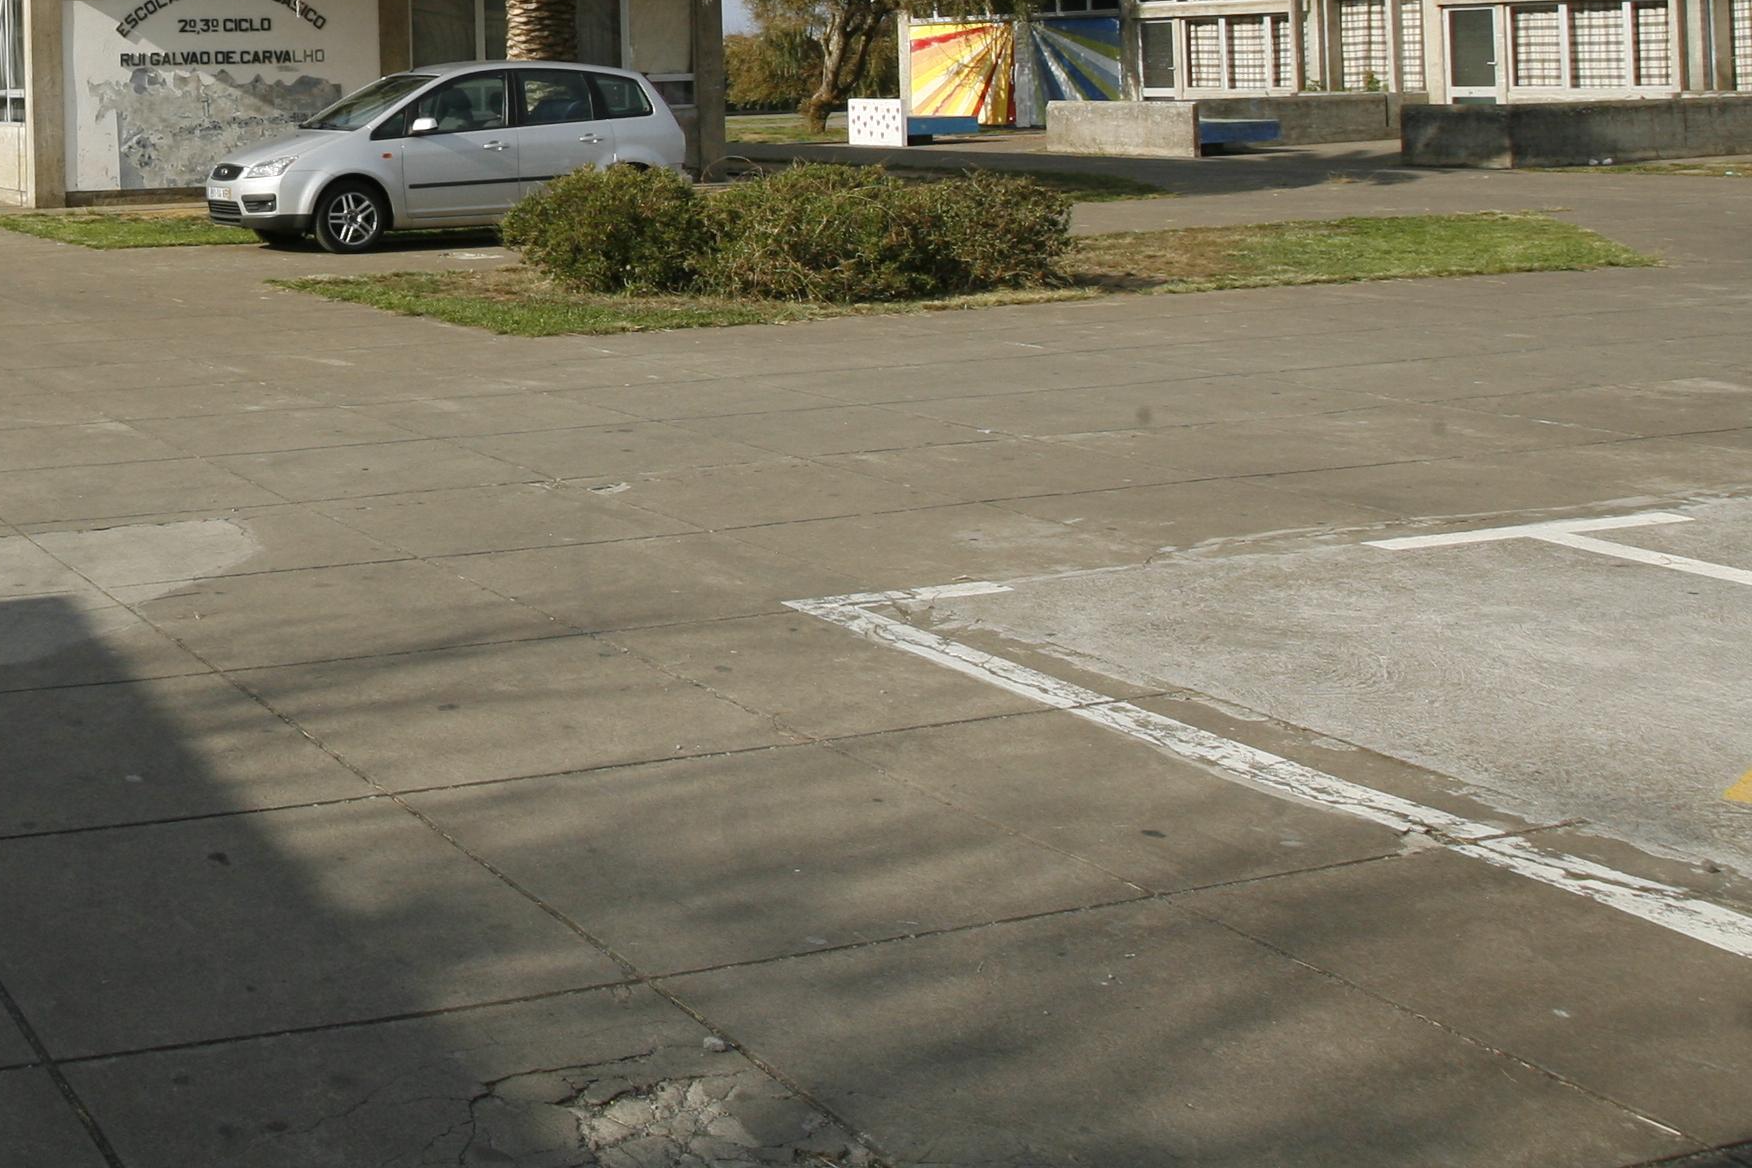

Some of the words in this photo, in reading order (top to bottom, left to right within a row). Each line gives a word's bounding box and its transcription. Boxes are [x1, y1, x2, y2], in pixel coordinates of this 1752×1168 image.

[223, 17, 272, 33] CICLO
[119, 52, 146, 68] RUI
[240, 48, 325, 65] CARVALHO
